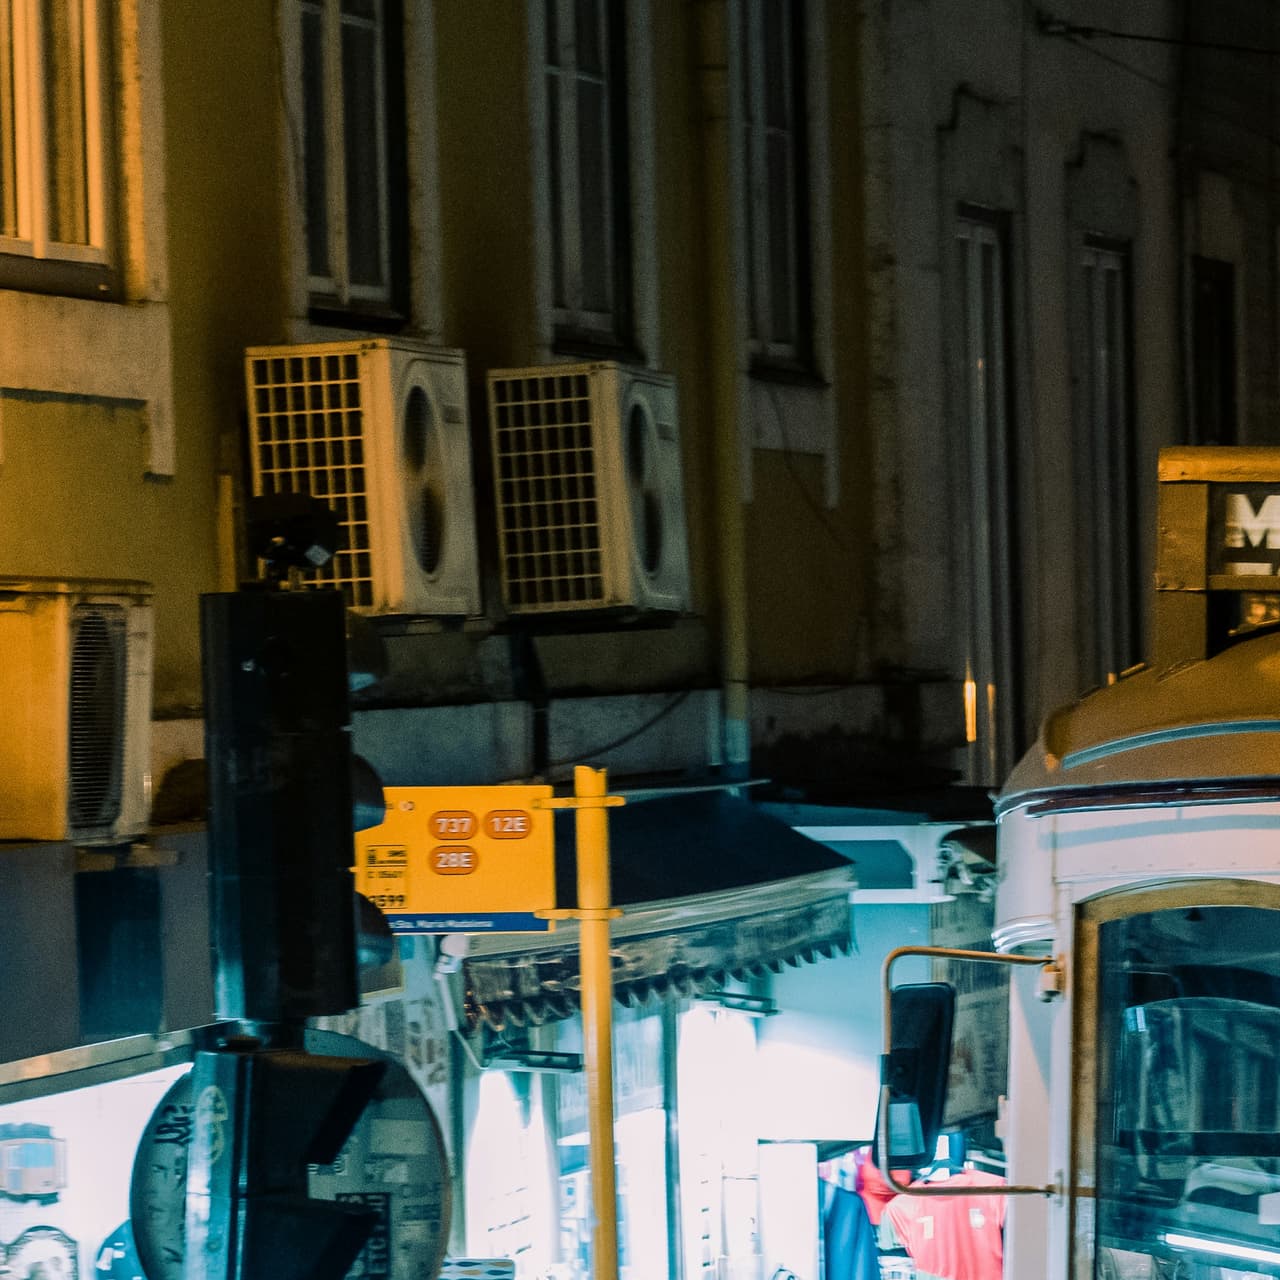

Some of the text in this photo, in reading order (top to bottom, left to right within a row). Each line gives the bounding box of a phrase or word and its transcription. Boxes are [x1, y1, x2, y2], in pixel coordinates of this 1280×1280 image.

[436, 816, 527, 833] 737 12E
[436, 852, 473, 868] 28E
